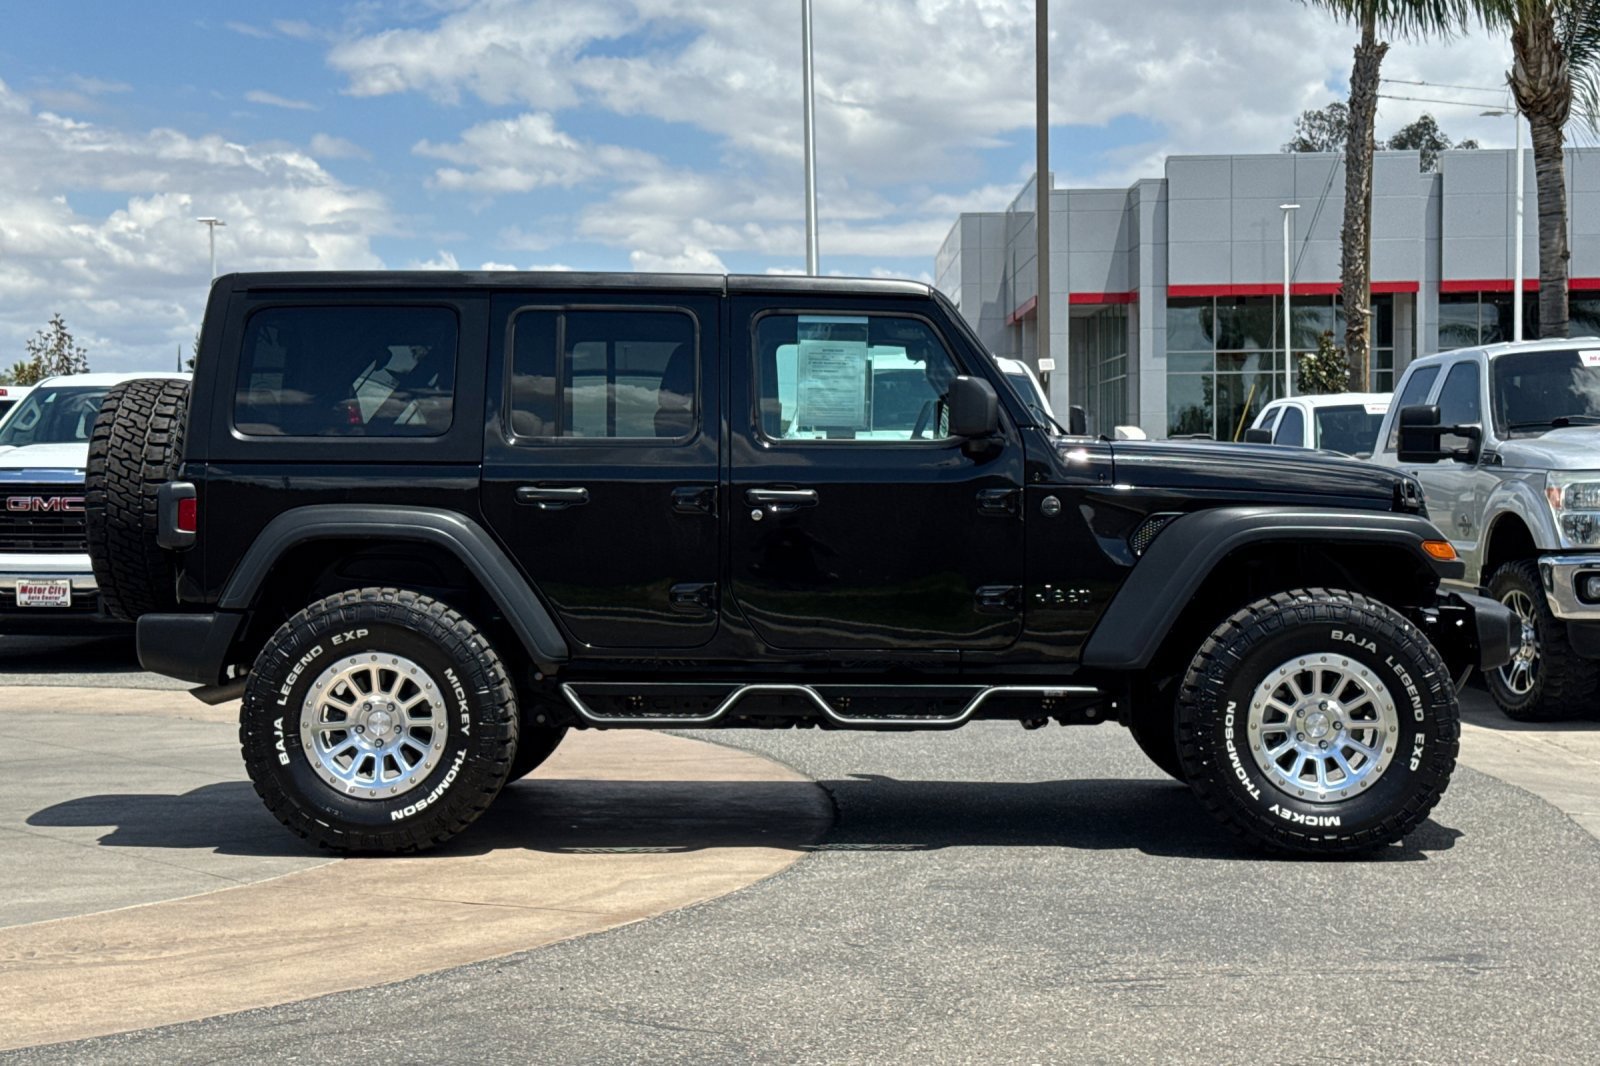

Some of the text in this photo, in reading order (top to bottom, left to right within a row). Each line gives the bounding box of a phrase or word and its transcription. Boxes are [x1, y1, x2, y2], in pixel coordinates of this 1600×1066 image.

[6, 496, 86, 512] GMC
[20, 585, 68, 598] Motor City
[1034, 583, 1092, 606] Jeep
[273, 628, 369, 766] BAJA LEGEND EXP
[391, 667, 471, 821] MICKEY THOMPSON
[1331, 629, 1425, 772] BAJA LEGEND EXP
[1225, 701, 1341, 827] MICKEY THOMPSON
